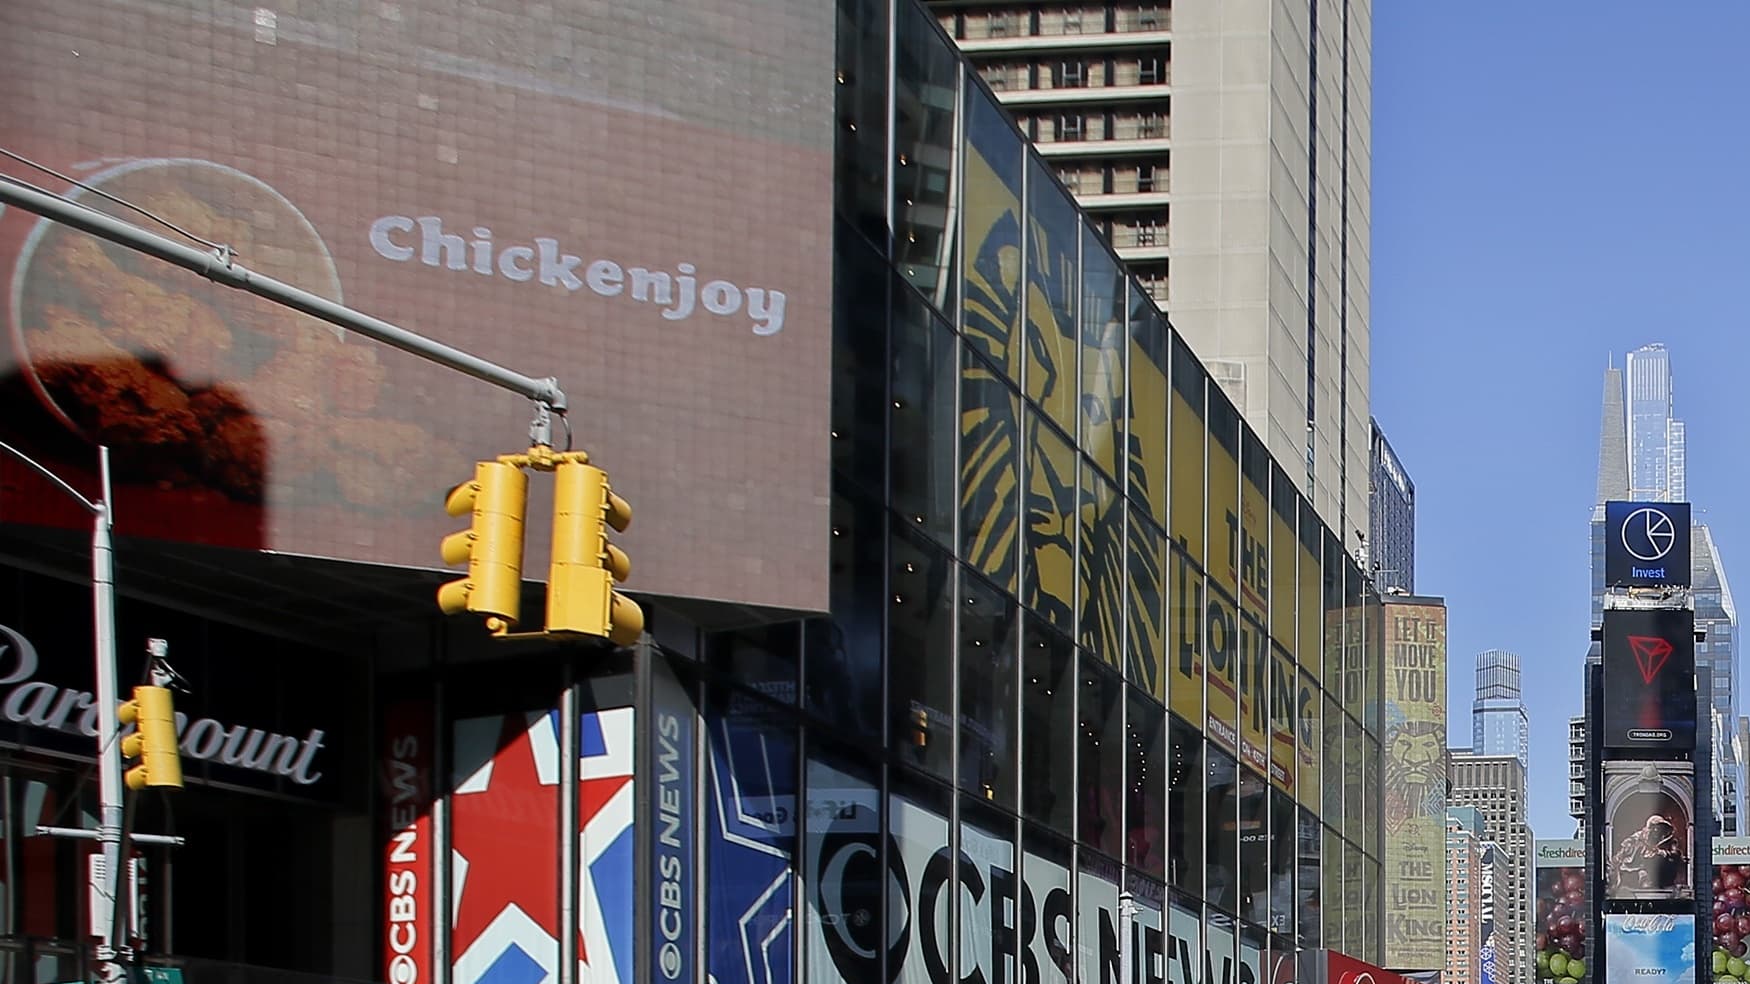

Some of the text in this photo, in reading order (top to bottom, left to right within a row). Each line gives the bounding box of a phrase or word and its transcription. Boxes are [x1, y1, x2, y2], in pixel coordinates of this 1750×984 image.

[369, 215, 787, 336] Chickenjoy
[1226, 508, 1267, 598] THE
[1631, 566, 1665, 579] Invest
[1179, 535, 1314, 749] LION KING
[1393, 617, 1420, 643] LET
[1394, 644, 1437, 670] MOVE
[1396, 669, 1437, 702] YOU
[0, 624, 325, 785] Parount
[658, 714, 682, 941] CBS NEWS
[389, 735, 420, 954] CBS NEWS
[1542, 846, 1586, 861] freshdirec
[1713, 845, 1750, 857] shdirect
[1398, 860, 1434, 877] THE
[1392, 883, 1438, 911] LION
[1386, 913, 1444, 944] KING
[1634, 968, 1667, 976] READY?
